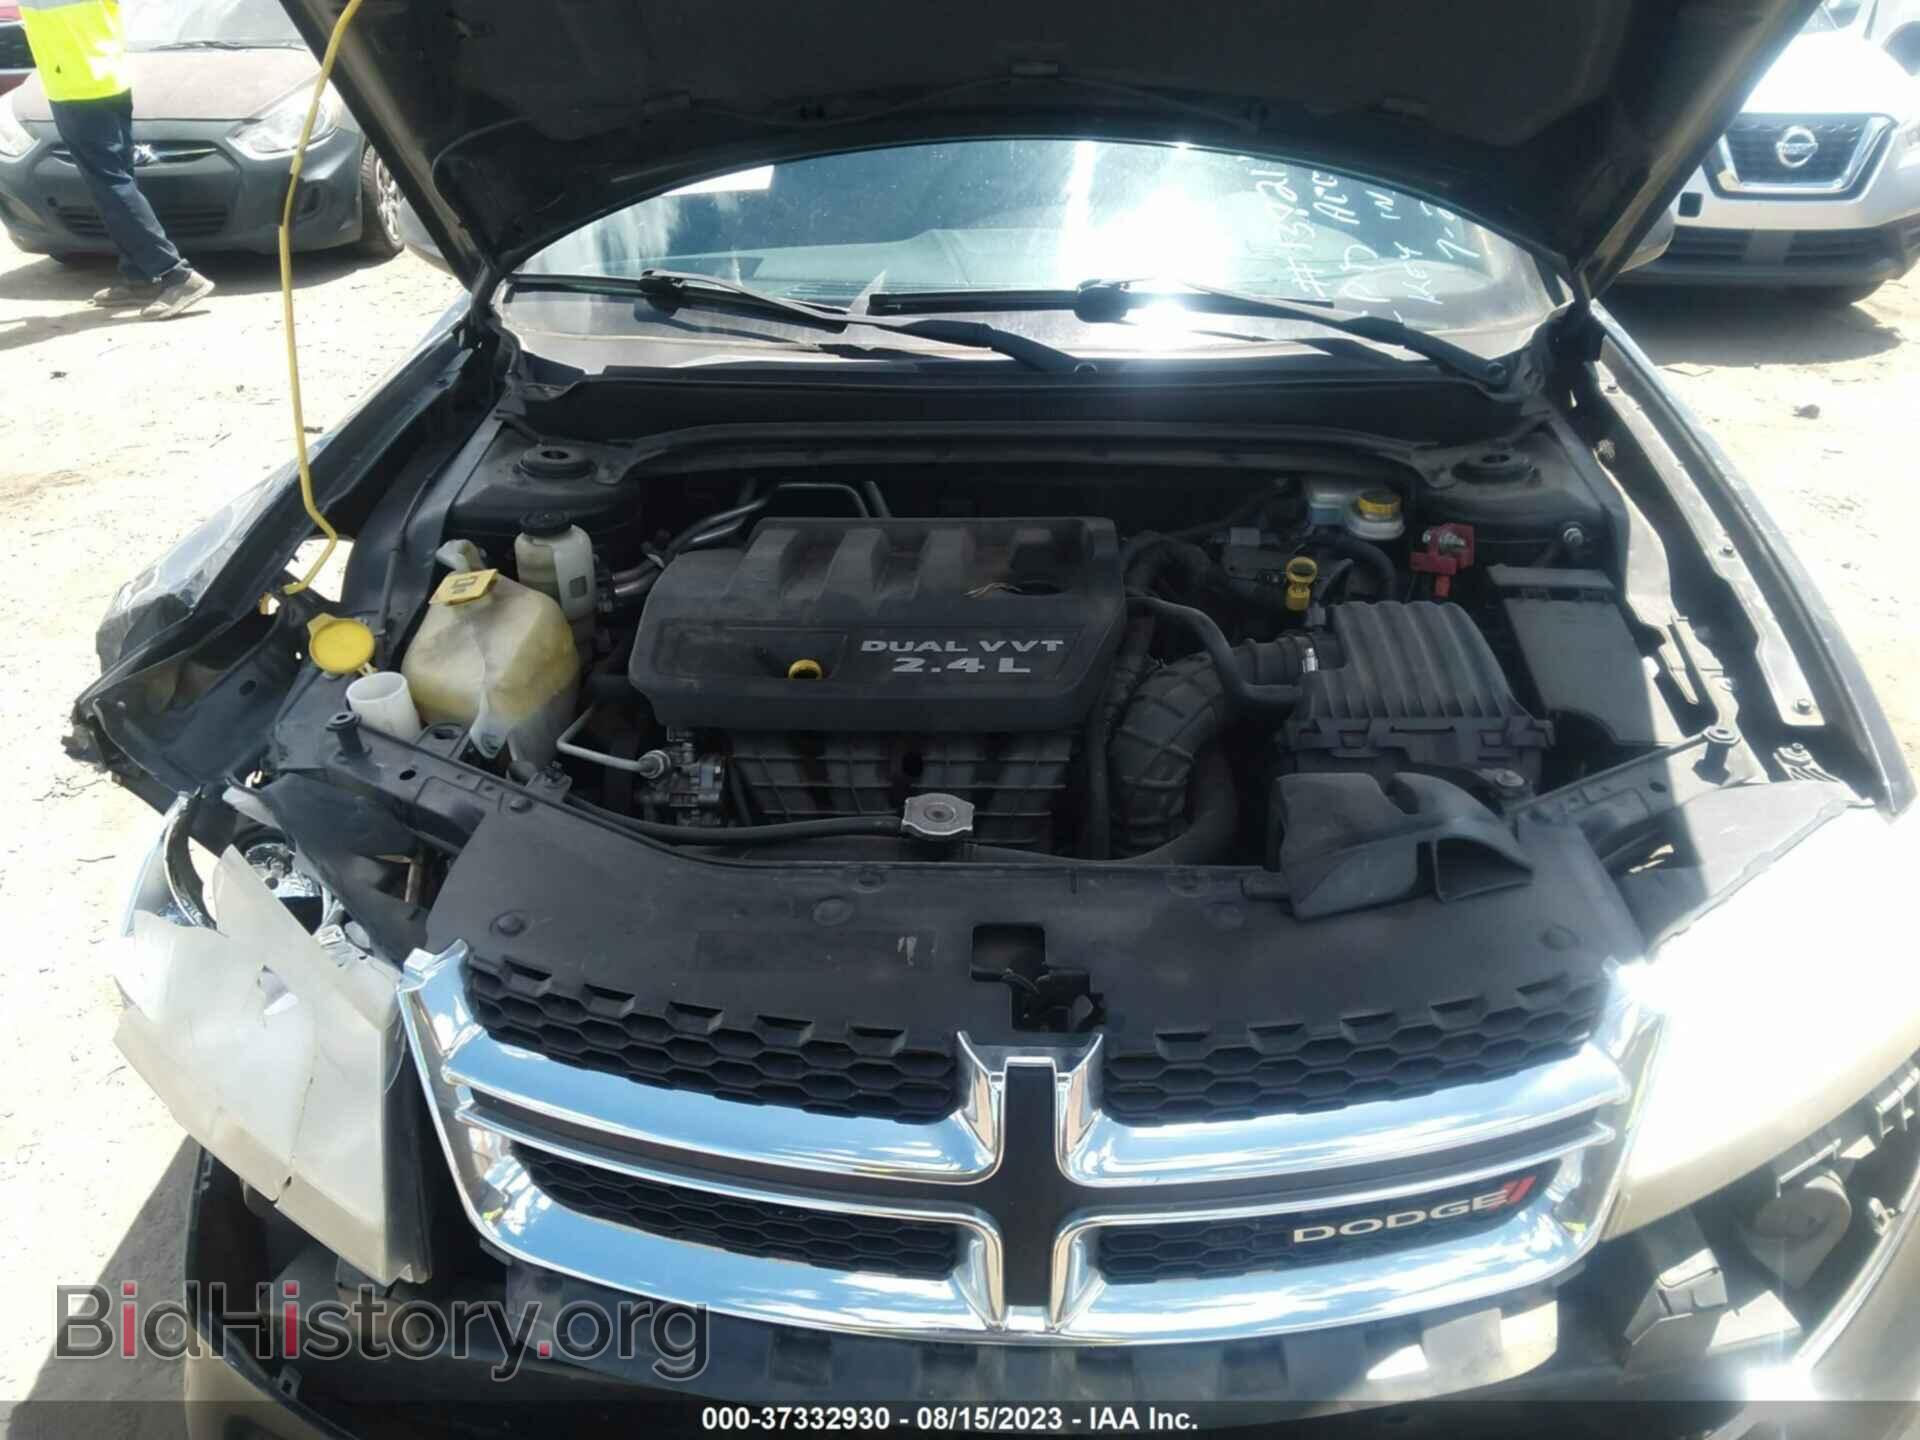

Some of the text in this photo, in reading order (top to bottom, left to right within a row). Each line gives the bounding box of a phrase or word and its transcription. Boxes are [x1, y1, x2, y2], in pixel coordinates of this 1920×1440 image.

[860, 640, 1065, 652] DUAL VVT
[1293, 1188, 1509, 1243] DODGE
